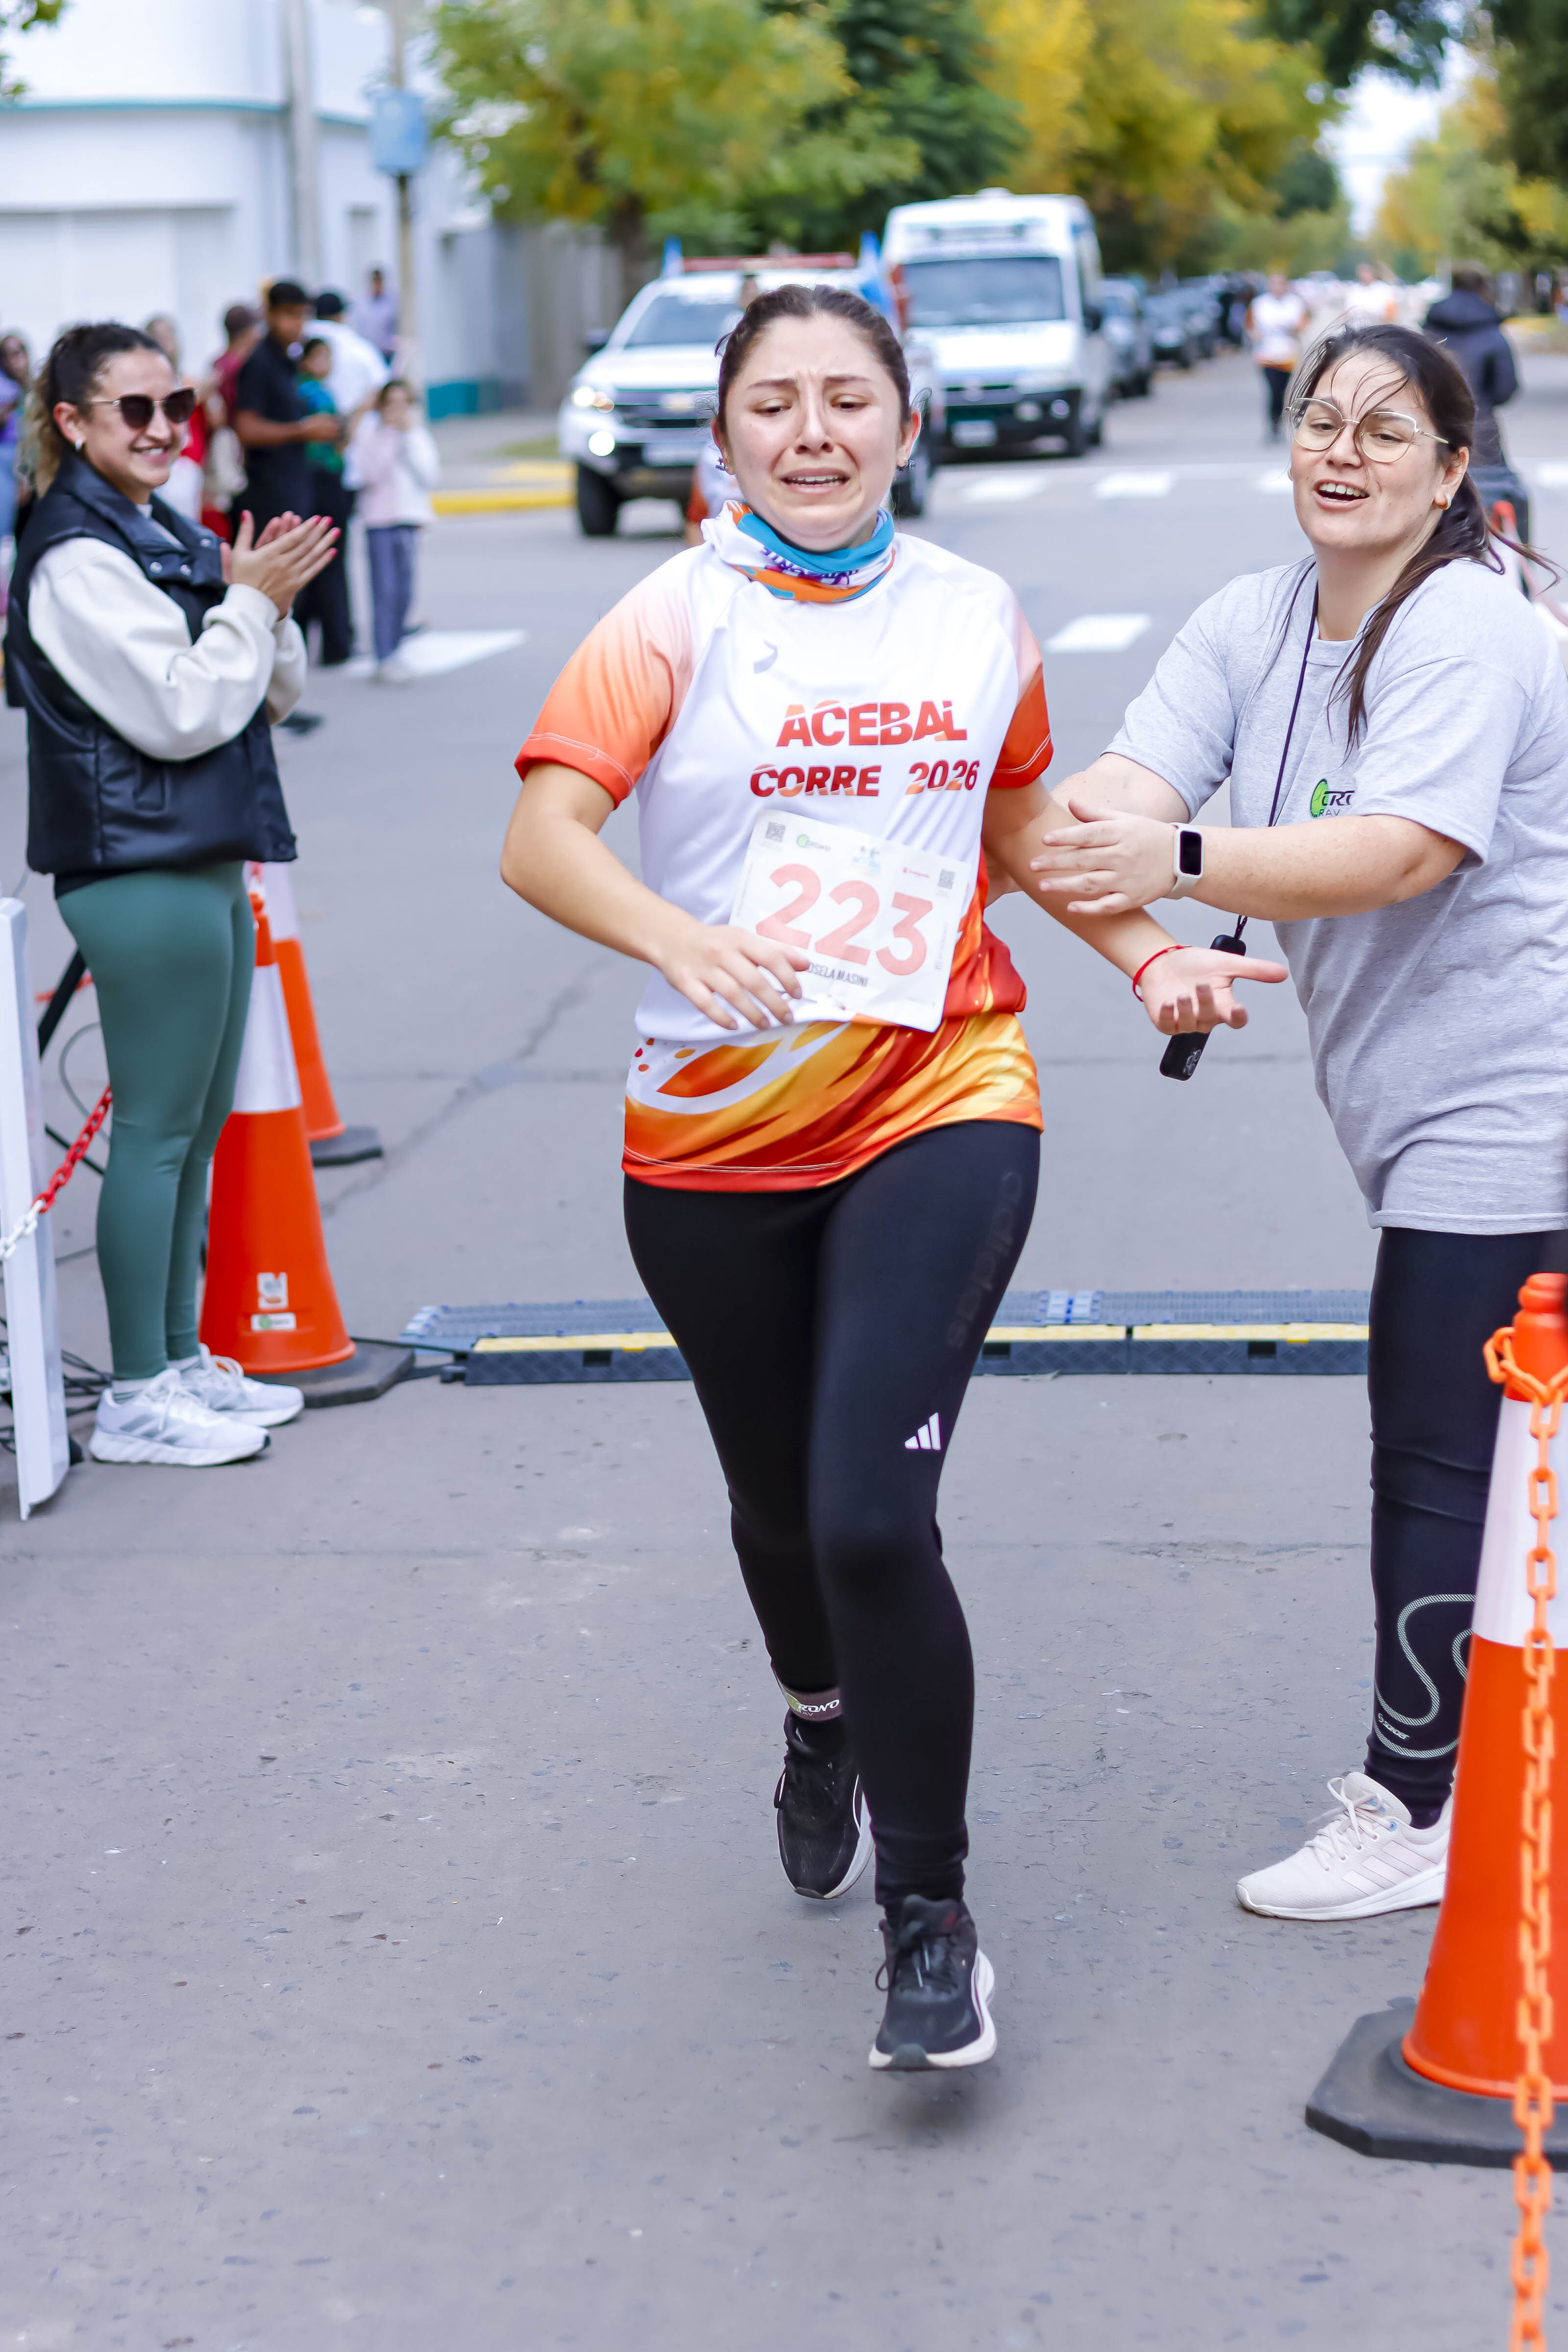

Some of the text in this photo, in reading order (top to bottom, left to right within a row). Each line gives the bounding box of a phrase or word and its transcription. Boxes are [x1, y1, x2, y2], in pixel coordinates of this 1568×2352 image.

[776, 700, 967, 747] ACEBAL
[750, 760, 980, 797] CORRE 2026
[756, 863, 933, 976] 223
